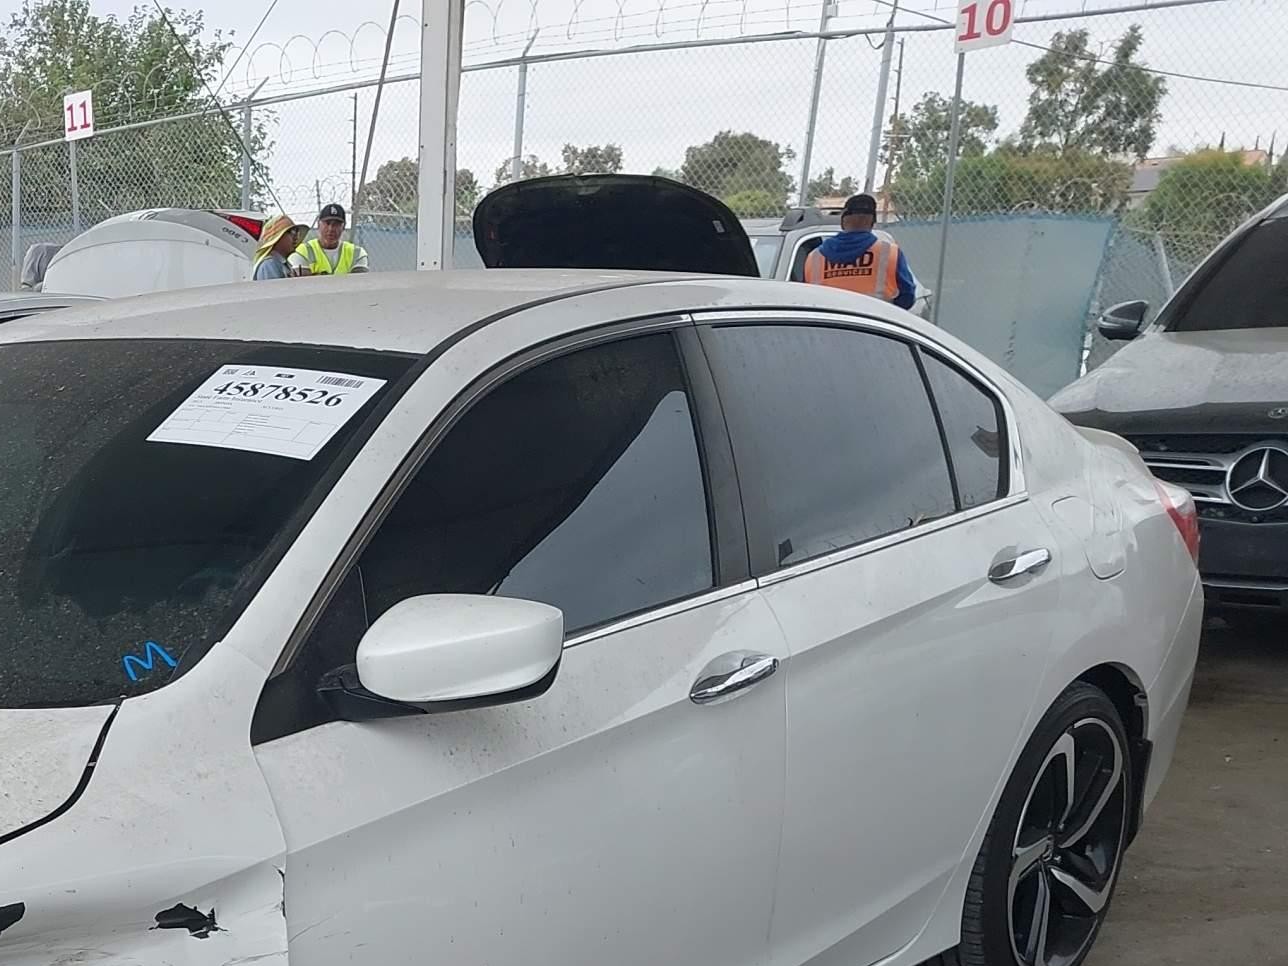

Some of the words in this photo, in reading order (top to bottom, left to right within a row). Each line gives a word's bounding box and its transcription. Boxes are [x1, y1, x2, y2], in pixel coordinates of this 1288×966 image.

[958, 0, 1011, 41] 10
[66, 100, 90, 132] 11
[824, 251, 873, 271] MD
[826, 268, 871, 279] SERVICES
[214, 381, 348, 407] 45878526
[122, 641, 177, 681] M
